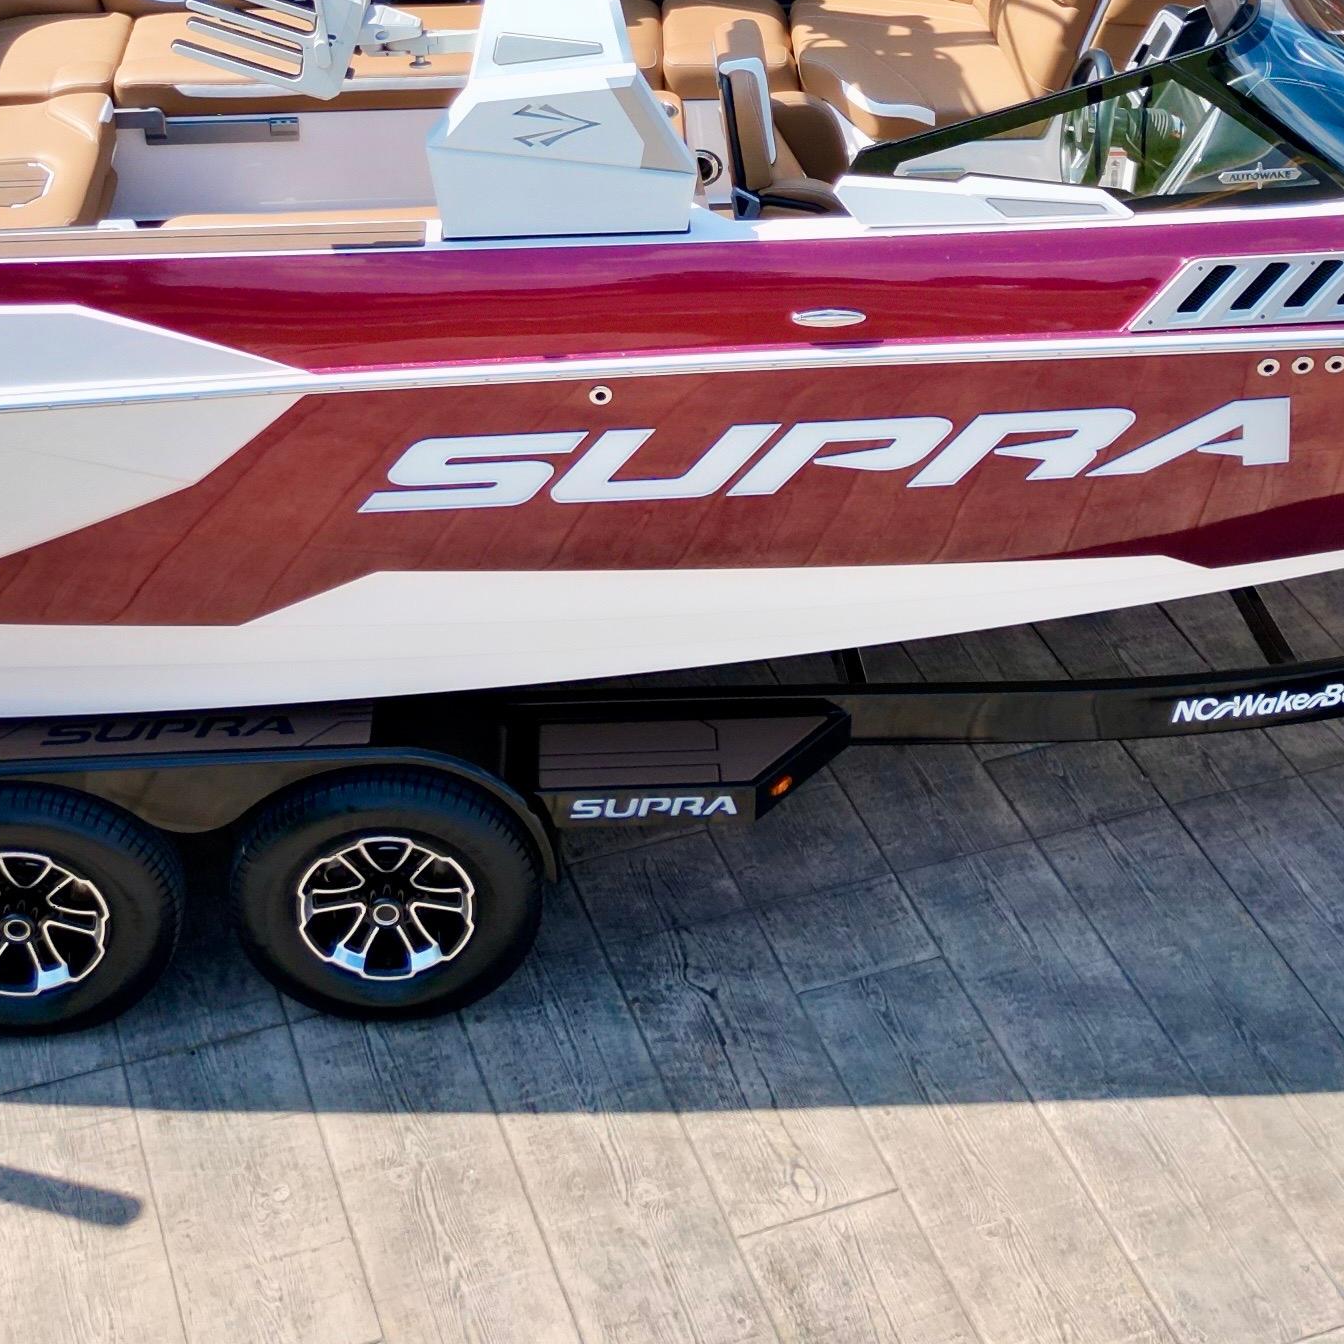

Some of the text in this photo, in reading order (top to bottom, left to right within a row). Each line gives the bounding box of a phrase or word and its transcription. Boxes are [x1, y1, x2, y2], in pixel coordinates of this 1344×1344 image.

[357, 397, 1291, 514] SUPRA
[40, 715, 296, 746] SUPRA
[570, 795, 738, 819] SUPRA
